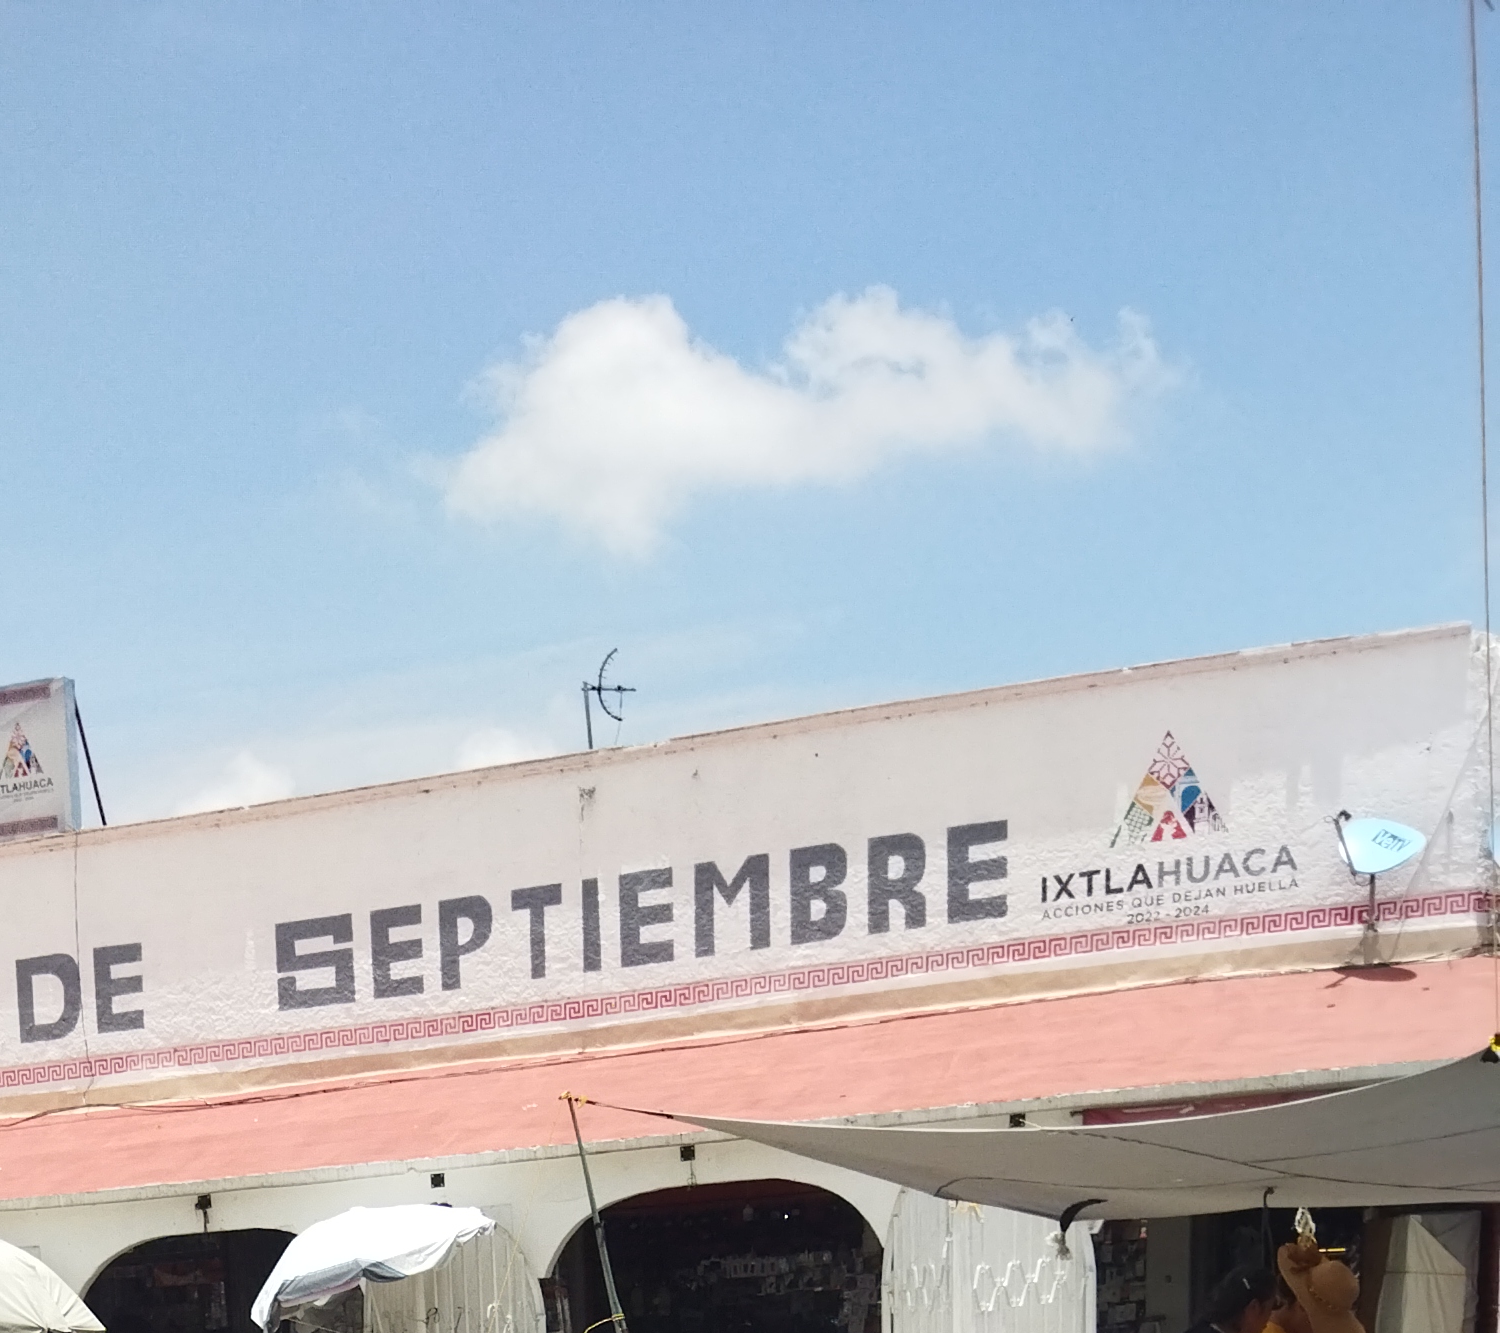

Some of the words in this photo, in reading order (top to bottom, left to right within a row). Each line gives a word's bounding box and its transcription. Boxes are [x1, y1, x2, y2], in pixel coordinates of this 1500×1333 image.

[1040, 844, 1298, 904] IXTLAHUACA
[1041, 900, 1125, 921] ACCIONES
[1131, 893, 1165, 909] QUE
[1172, 887, 1226, 903] DEJAN
[1233, 877, 1300, 895] HUELLA
[16, 942, 144, 1044] DE
[274, 820, 1008, 1010] SEPTIEMBRE
[1174, 904, 1210, 919] 2024
